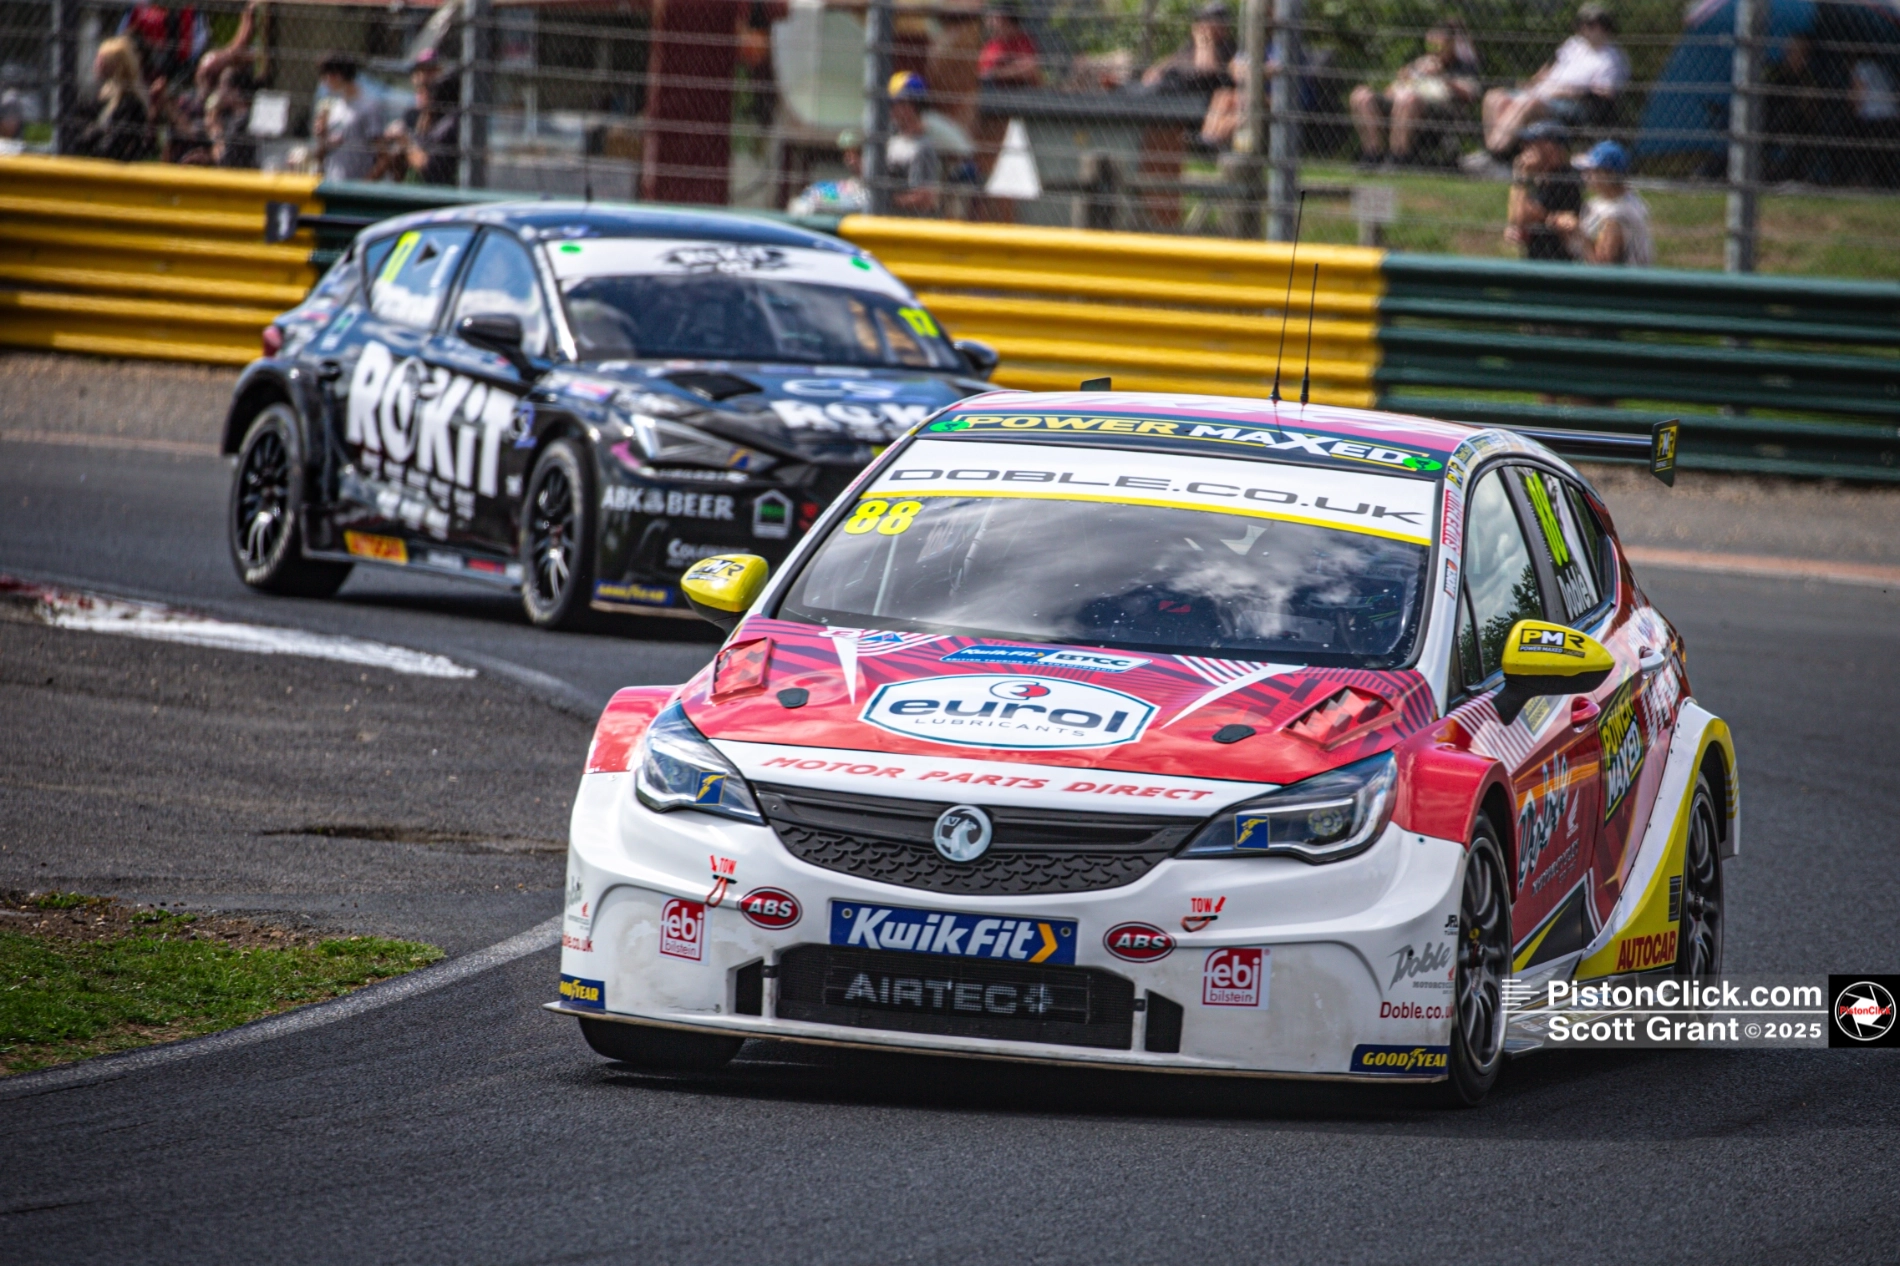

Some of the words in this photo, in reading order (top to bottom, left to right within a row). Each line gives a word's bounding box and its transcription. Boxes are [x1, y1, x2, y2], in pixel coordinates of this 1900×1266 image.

[967, 416, 1180, 434] POWER
[1188, 425, 1413, 463] MAXED
[666, 489, 735, 521] BEER
[888, 468, 1427, 526] DOBLE.CO.UK
[843, 500, 924, 535] 88
[1525, 473, 1569, 567] 88
[1522, 629, 1585, 650] PMR
[1055, 654, 1132, 667] BTCC
[887, 698, 1129, 734] eurol
[915, 718, 1085, 737] LUBRICANTS
[761, 757, 906, 779] MOTOR
[916, 770, 1051, 789] PARTS
[1061, 781, 1214, 801] DIRECT
[1608, 716, 1641, 809] MAXED
[719, 858, 737, 875] TOW
[747, 899, 793, 919] ABS
[1191, 898, 1213, 913] TOW
[665, 939, 697, 957] bilstein
[1114, 932, 1167, 950] ABS
[1617, 930, 1676, 971] AUTOCAR
[1387, 941, 1452, 991] Doble
[845, 973, 1017, 1014] AIRTEC
[1209, 990, 1254, 1003] bilstein
